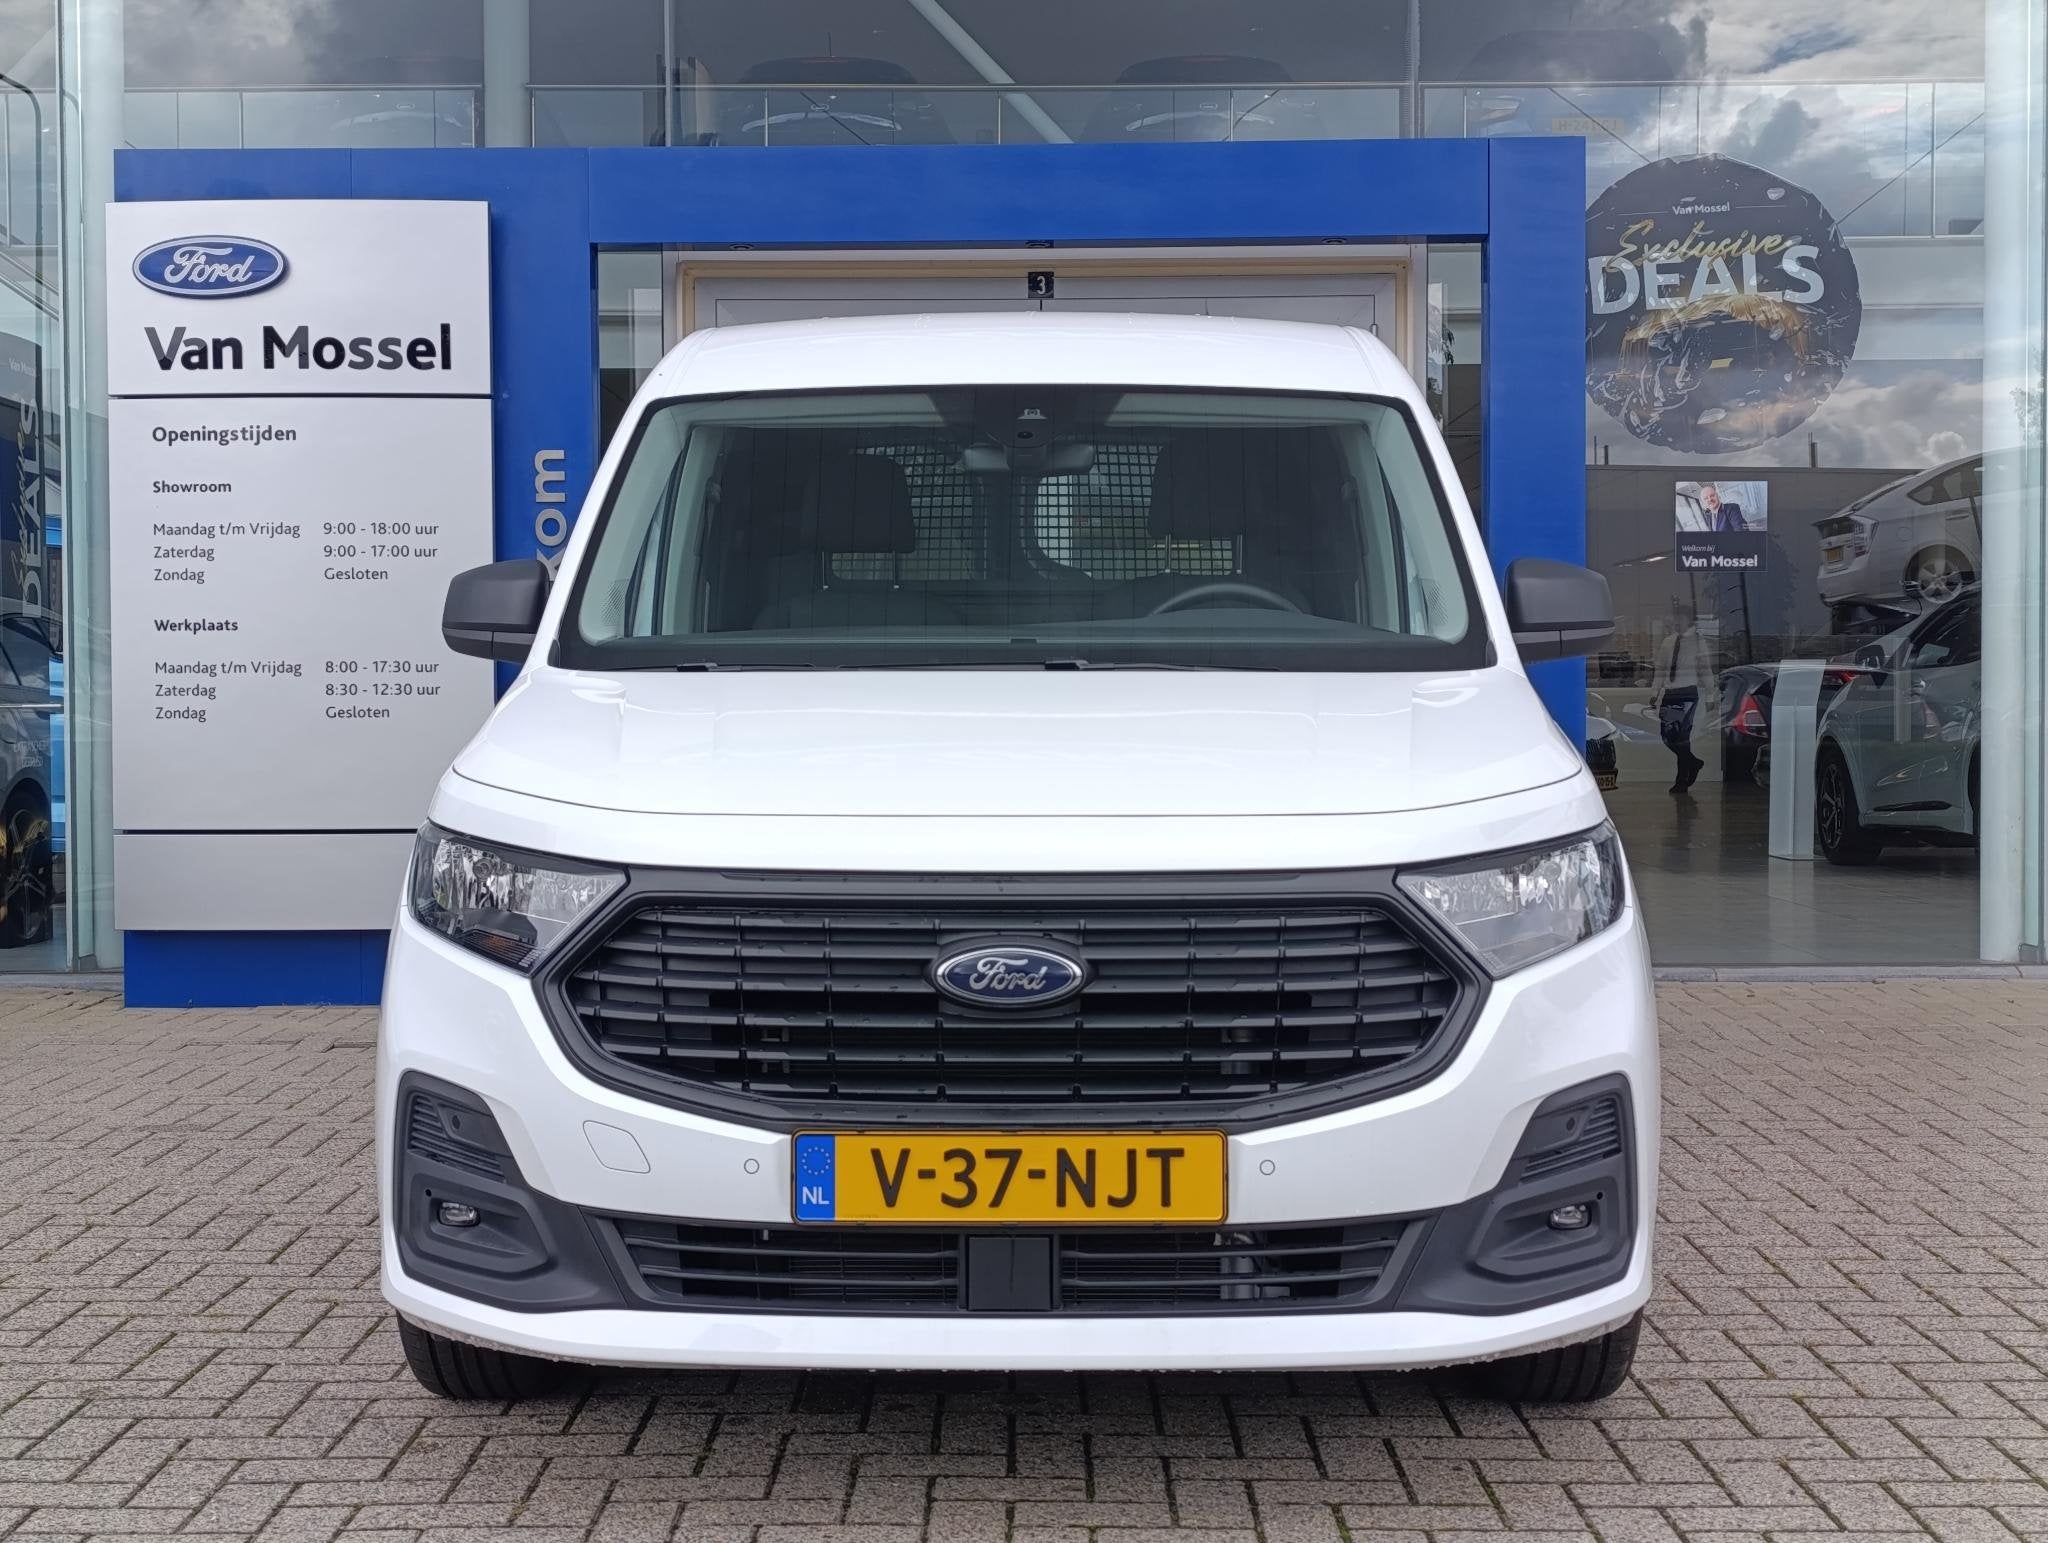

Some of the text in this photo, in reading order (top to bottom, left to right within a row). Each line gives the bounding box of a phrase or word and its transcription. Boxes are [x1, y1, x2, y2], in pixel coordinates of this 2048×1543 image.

[1673, 202, 1731, 215] Van Mossel
[1604, 219, 1798, 273] Exclusive
[164, 246, 254, 284] Ford
[1036, 275, 1046, 295] 3
[1588, 244, 1825, 315] DEALS
[144, 323, 452, 370] Van Mossel
[152, 425, 297, 446] Openingstijden
[153, 480, 232, 494] Showroom
[21, 398, 42, 618] DEALS
[153, 521, 301, 539] Maandag t/m Vrijdag
[324, 522, 356, 535] 9:00
[371, 522, 411, 535] 18:00
[415, 526, 440, 535] uur
[154, 545, 215, 561] Zaterdag
[324, 545, 357, 558] 9:00
[371, 545, 410, 558] 17:00
[415, 549, 438, 558] uur
[1682, 544, 1716, 554] Welkom bij
[1682, 554, 1758, 568] Van Mossel
[154, 568, 205, 584] Zondag
[324, 567, 389, 580] Gesloten
[154, 618, 239, 635] Werkplaats
[155, 660, 302, 677] Maandag t/m Vrijdag
[326, 660, 358, 673] 8:00
[373, 660, 412, 673] 17:30
[416, 664, 440, 673] uur
[155, 684, 216, 700] Zaterdag
[326, 683, 358, 696] 8:30
[373, 683, 413, 696] 12:30
[417, 687, 441, 696] uur
[156, 707, 207, 723] Zondag
[326, 706, 390, 719] Gesloten
[969, 956, 1048, 991] Ford
[870, 1147, 1186, 1209] V-37-NJT
[802, 1186, 830, 1205] NL
